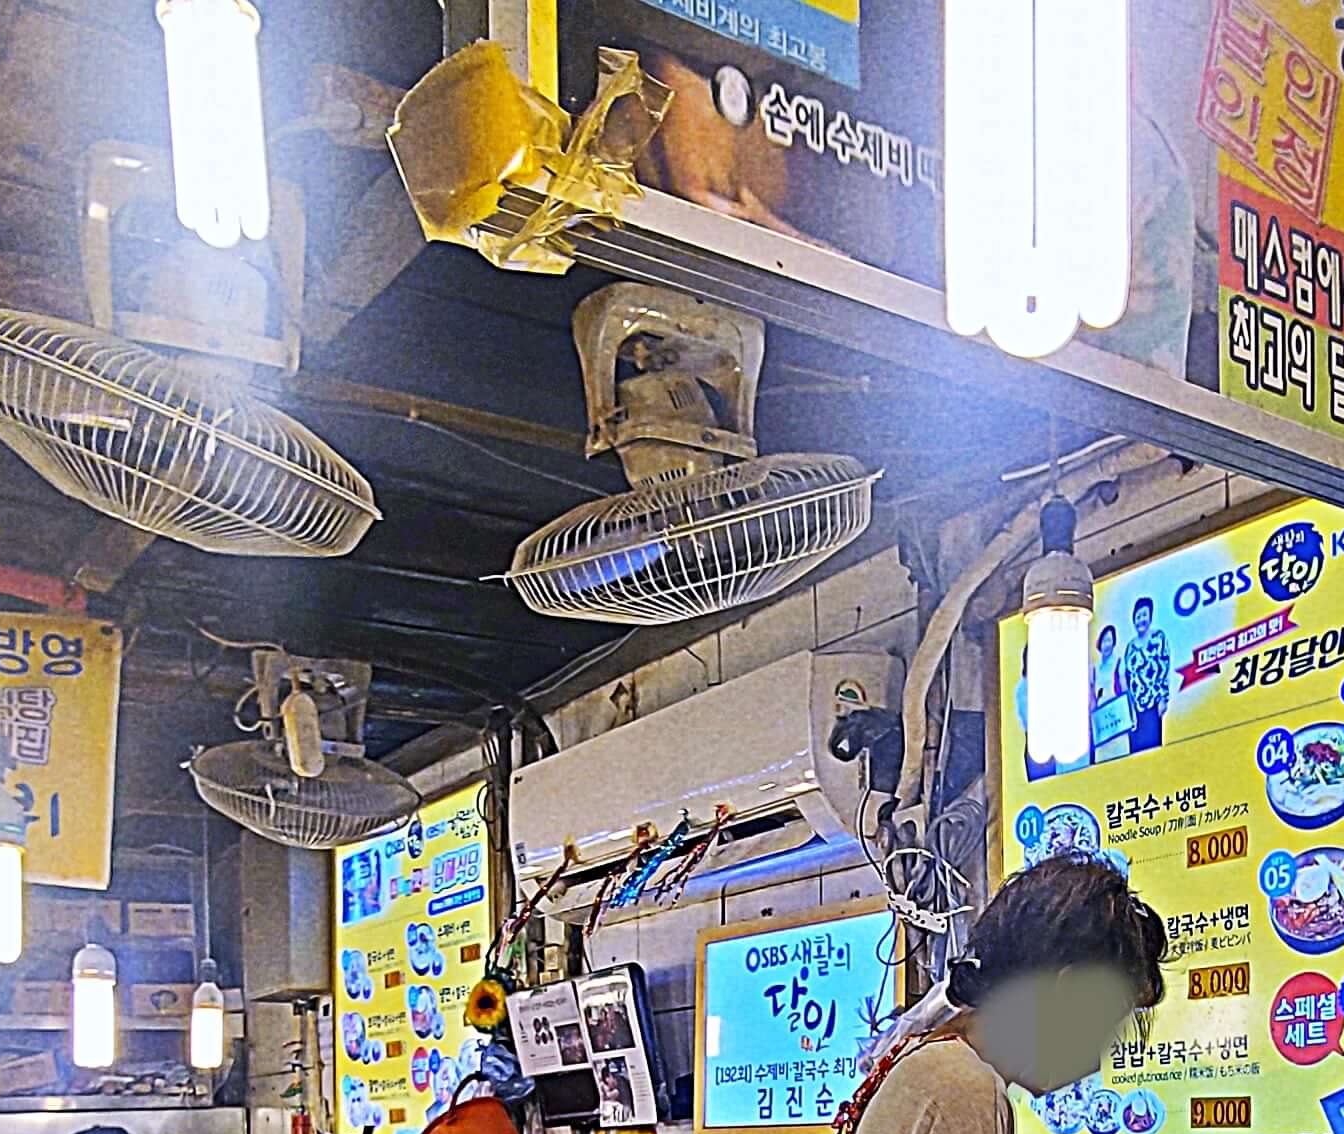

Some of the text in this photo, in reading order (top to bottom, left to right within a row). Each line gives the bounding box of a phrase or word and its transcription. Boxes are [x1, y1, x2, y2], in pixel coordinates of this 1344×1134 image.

[767, 26, 828, 73] 최고봉
[762, 84, 824, 153] 손에
[828, 111, 914, 186] 수제비
[1229, 296, 1315, 411] 최고의
[1261, 550, 1319, 591] 달인
[1262, 740, 1289, 768] 04
[1107, 793, 1161, 830] 칼국수
[1176, 783, 1208, 813] 냉면
[1020, 816, 1038, 840] 01
[1108, 827, 1139, 845] Noodle
[1139, 824, 1162, 840] Soup
[1189, 829, 1246, 867] 8.000
[1264, 863, 1291, 891] 05
[791, 933, 852, 981] 생활의
[1191, 965, 1249, 998] 8.000
[764, 975, 837, 1052] 달인
[1274, 991, 1338, 1022] 스페셜
[1284, 1021, 1328, 1049] 세트
[1193, 1099, 1251, 1128] 9.000
